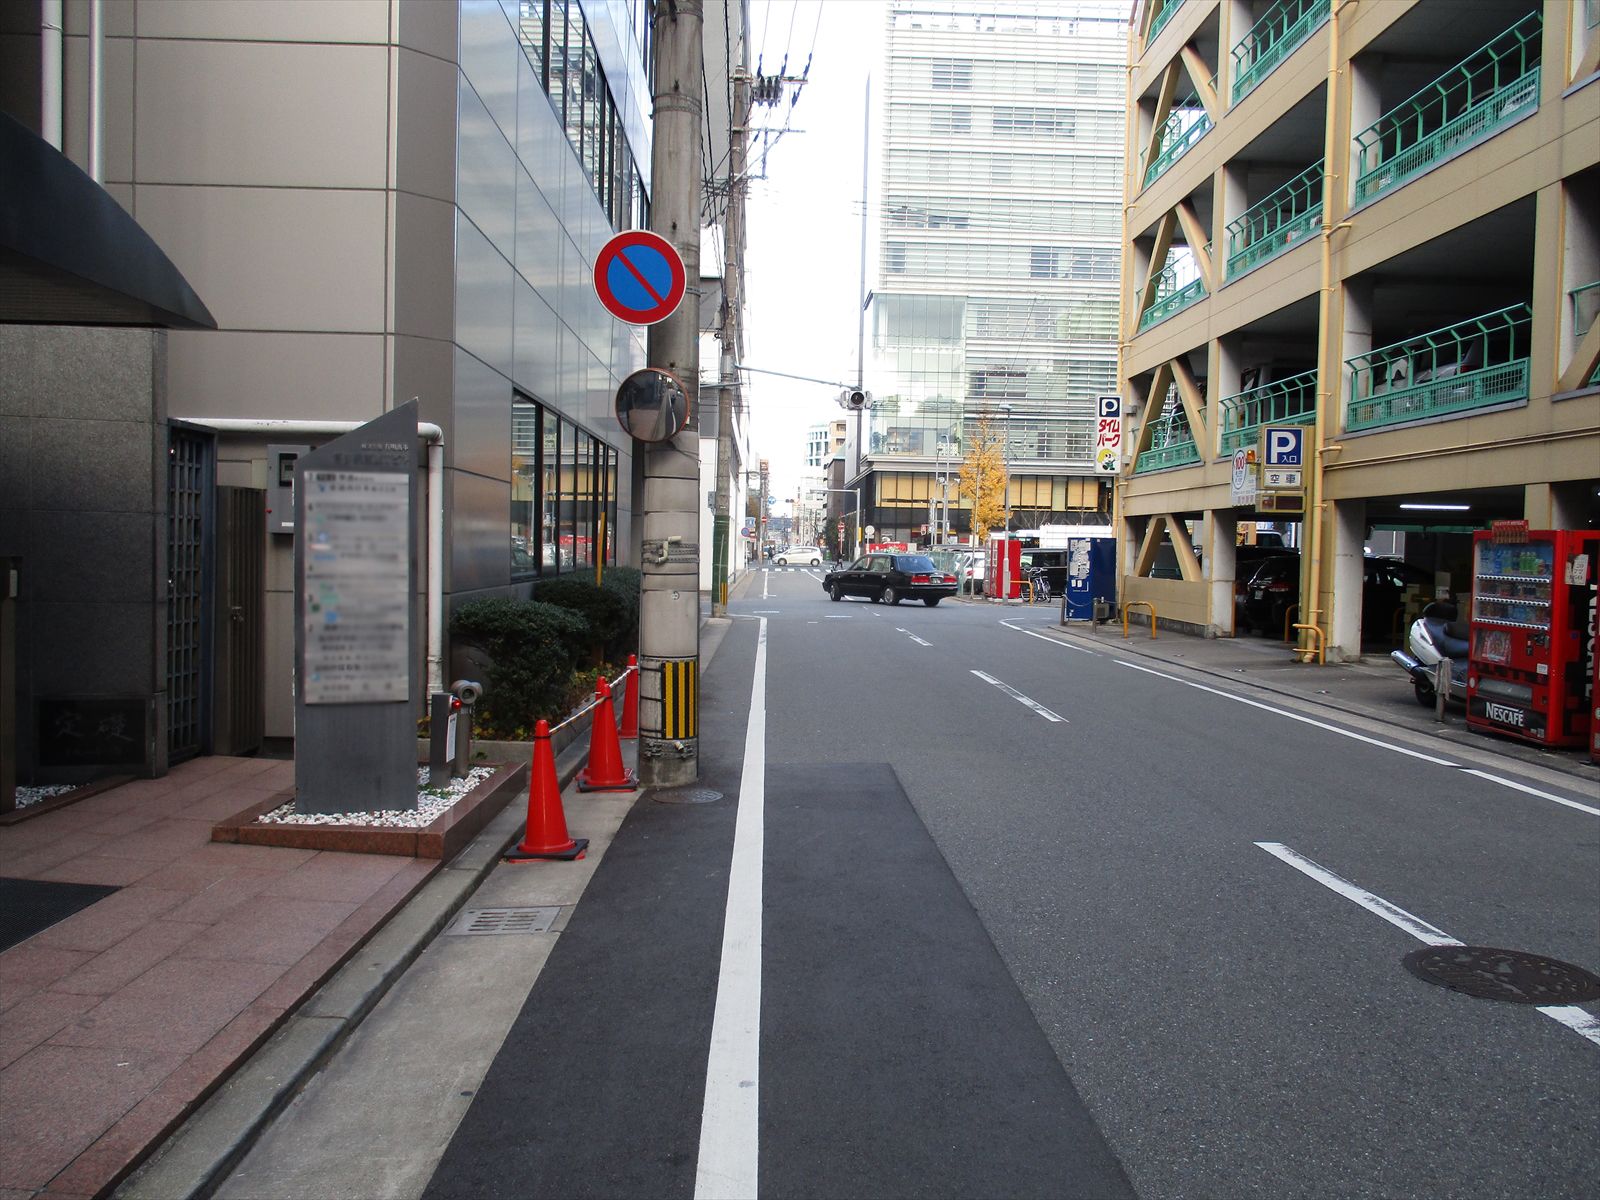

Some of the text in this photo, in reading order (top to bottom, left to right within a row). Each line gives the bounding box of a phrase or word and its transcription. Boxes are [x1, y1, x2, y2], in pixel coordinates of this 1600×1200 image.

[1101, 398, 1118, 416] P
[1098, 419, 1120, 433] タイム
[1097, 433, 1121, 447] パーク
[1270, 431, 1297, 463] P
[1281, 455, 1297, 463] 入口
